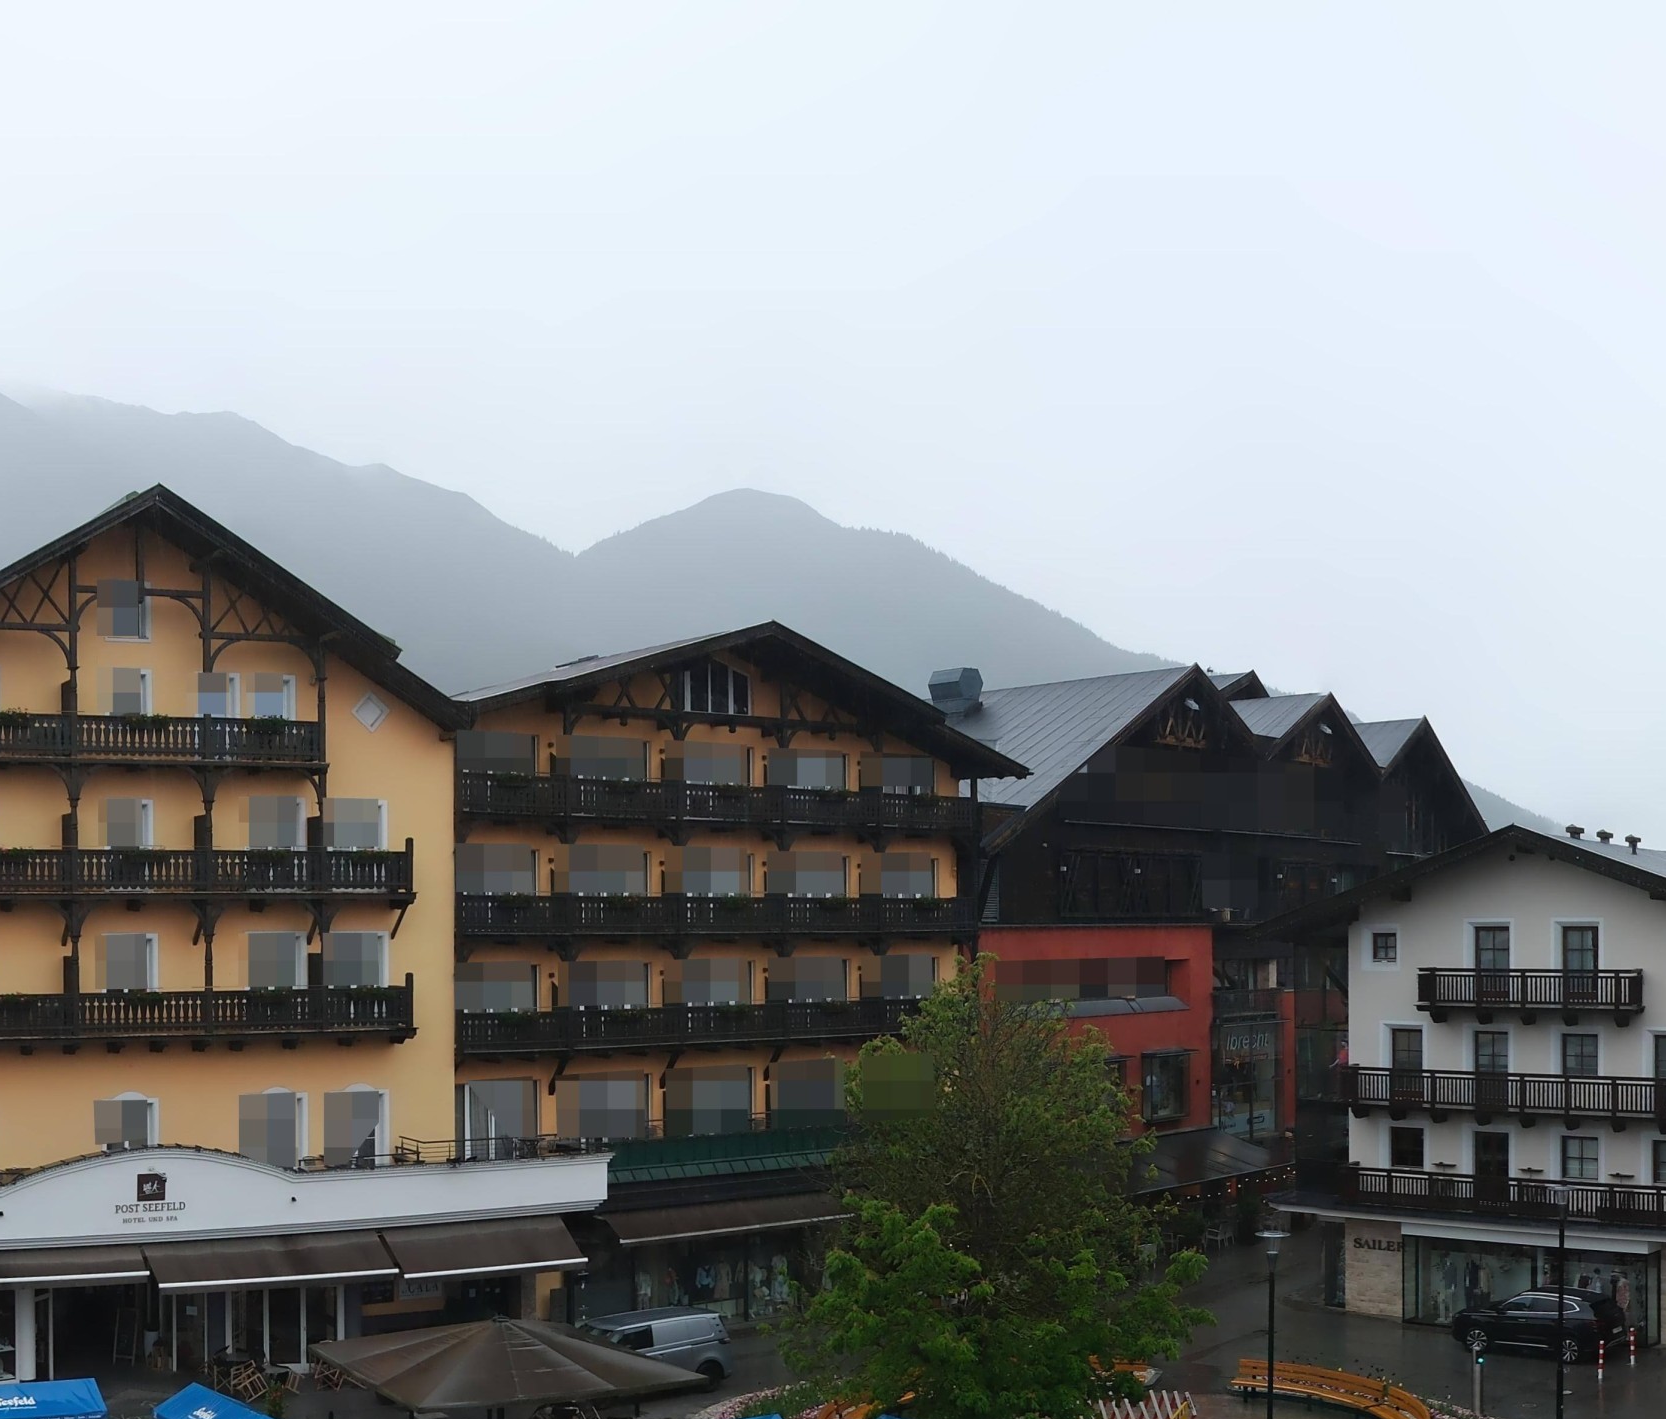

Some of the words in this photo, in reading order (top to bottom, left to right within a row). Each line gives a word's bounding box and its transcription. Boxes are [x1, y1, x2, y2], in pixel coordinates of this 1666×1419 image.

[115, 1203, 140, 1214] POST
[142, 1201, 186, 1212] SEEFELD
[1353, 1238, 1406, 1252] SAILER
